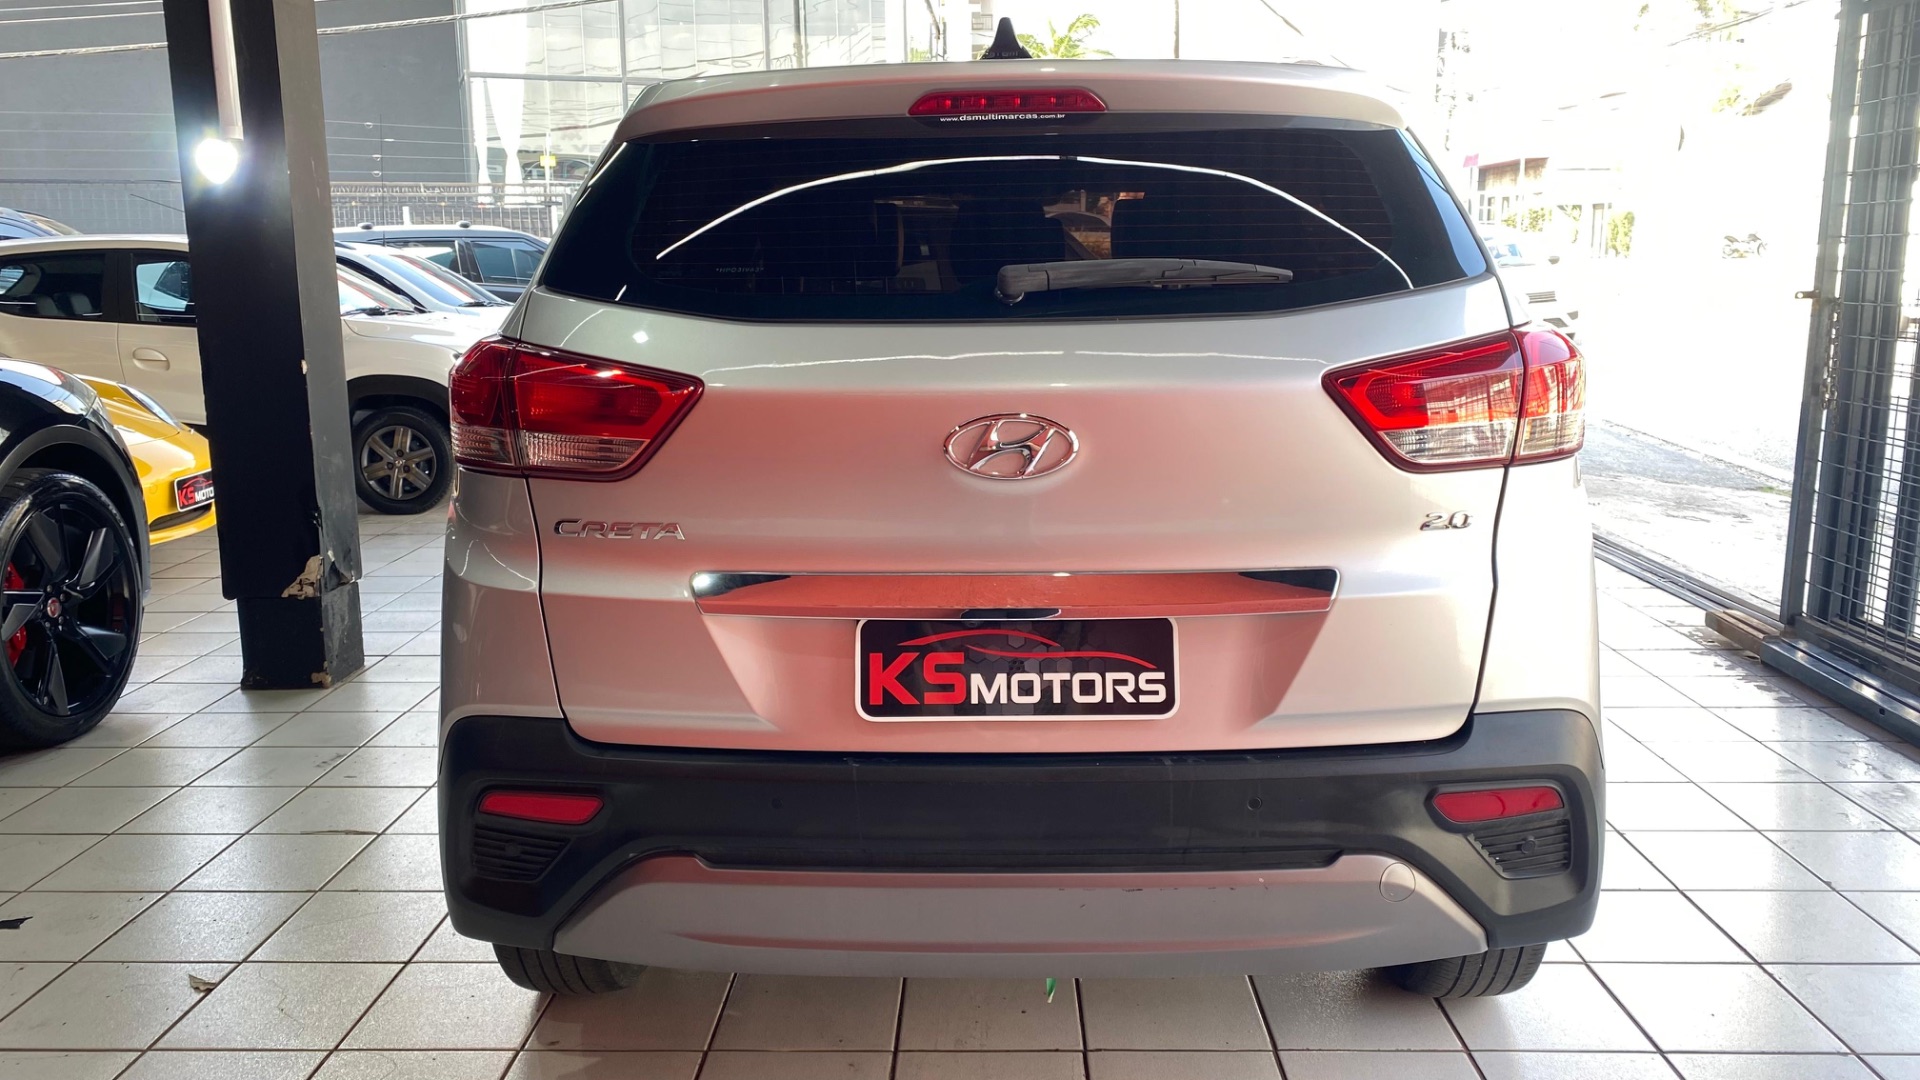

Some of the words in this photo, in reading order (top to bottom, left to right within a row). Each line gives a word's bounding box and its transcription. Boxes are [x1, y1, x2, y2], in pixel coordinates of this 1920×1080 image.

[939, 113, 1066, 122] www.dsmultimarcas.com.br
[553, 518, 686, 541] CRETA
[1419, 510, 1472, 531] 2.0
[868, 651, 968, 705] KS
[969, 671, 1168, 705] MOTORS
